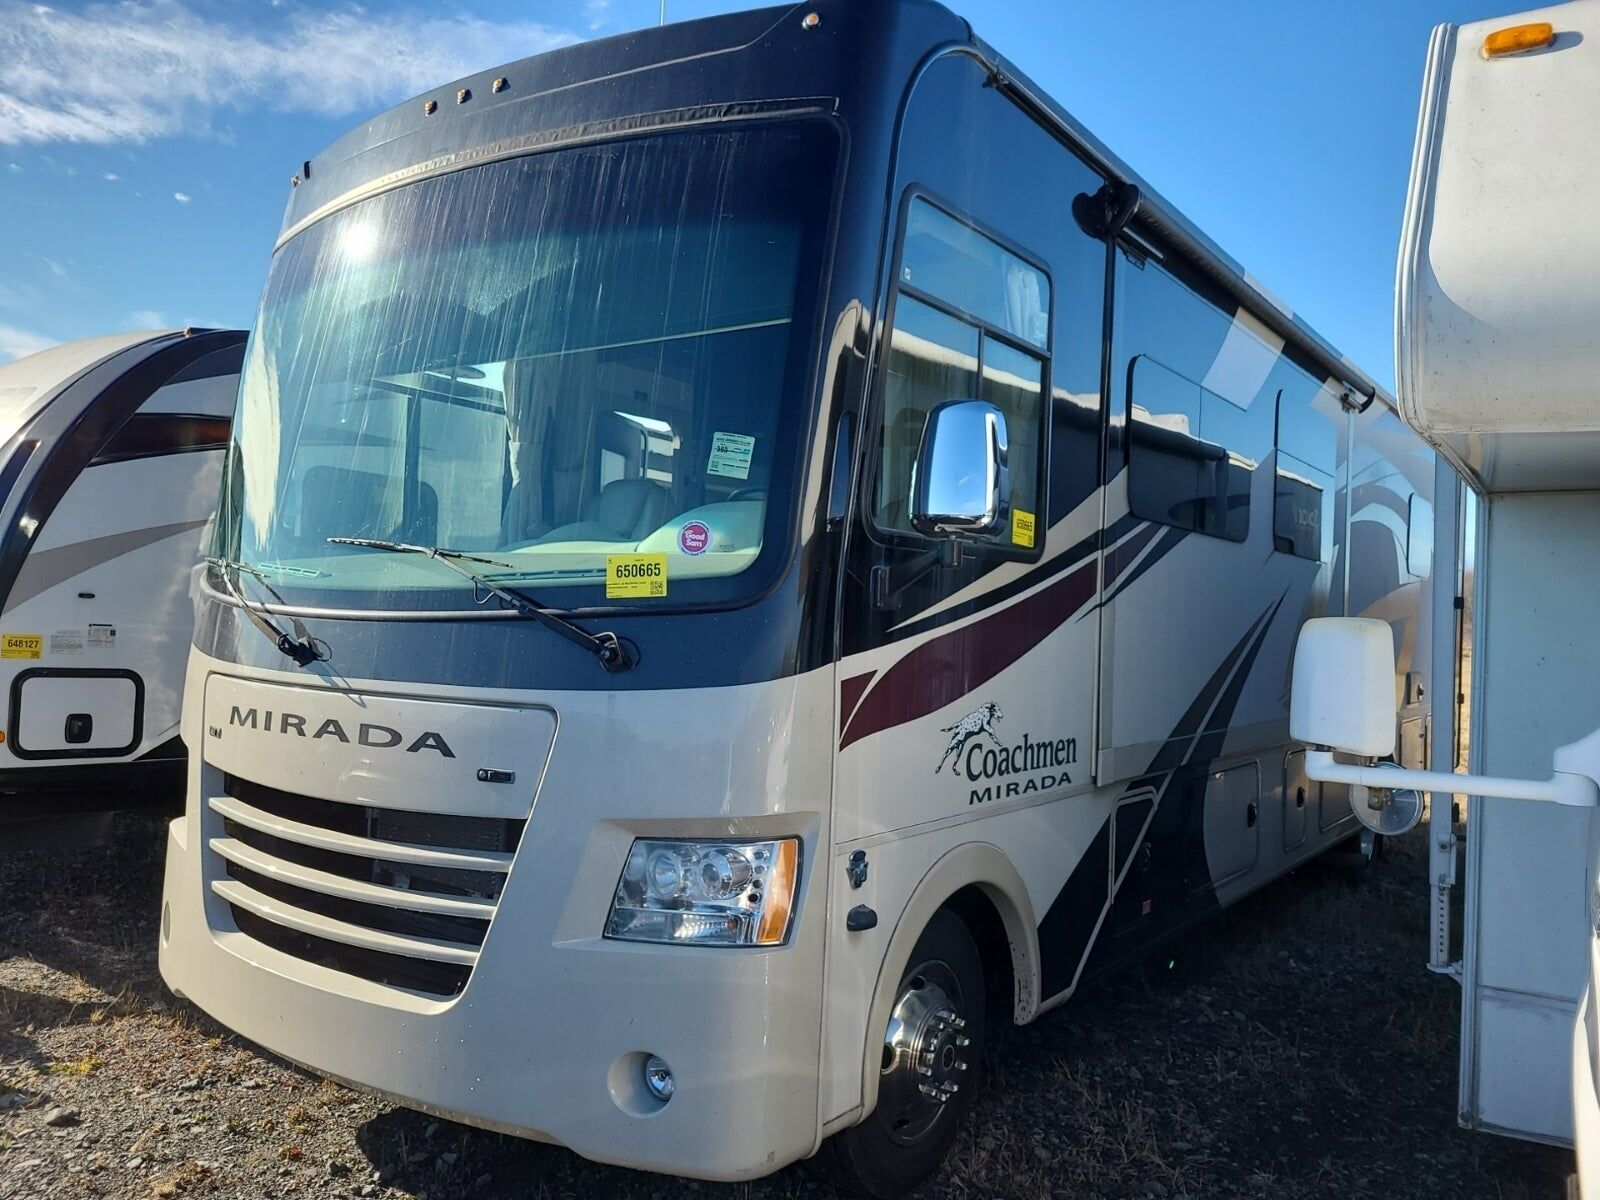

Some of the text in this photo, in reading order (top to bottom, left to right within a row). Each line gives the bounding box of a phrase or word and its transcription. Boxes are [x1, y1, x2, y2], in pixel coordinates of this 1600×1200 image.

[684, 529, 706, 541] Good
[686, 538, 703, 547] Sam
[616, 563, 661, 578] 650665
[8, 639, 39, 649] 648127
[229, 705, 456, 759] MIRADA
[966, 733, 1077, 782] Coachmen
[968, 772, 1072, 805] MIRADA
